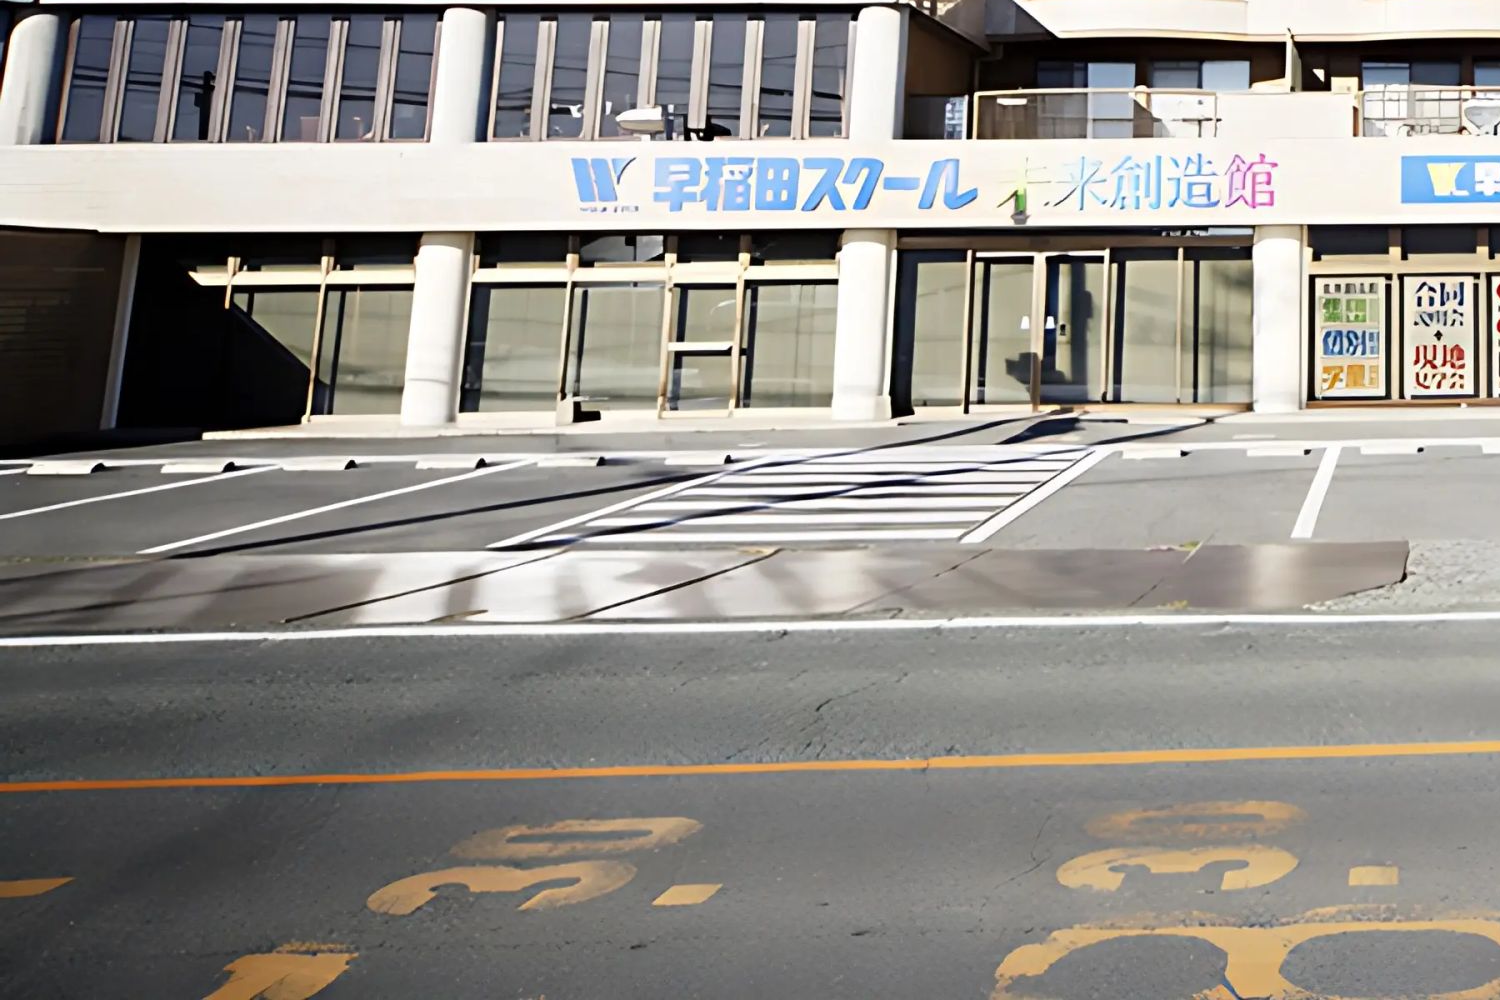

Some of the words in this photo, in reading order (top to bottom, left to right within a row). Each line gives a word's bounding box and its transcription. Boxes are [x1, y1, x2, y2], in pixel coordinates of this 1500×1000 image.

[653, 156, 979, 212] 早稲田スクール
